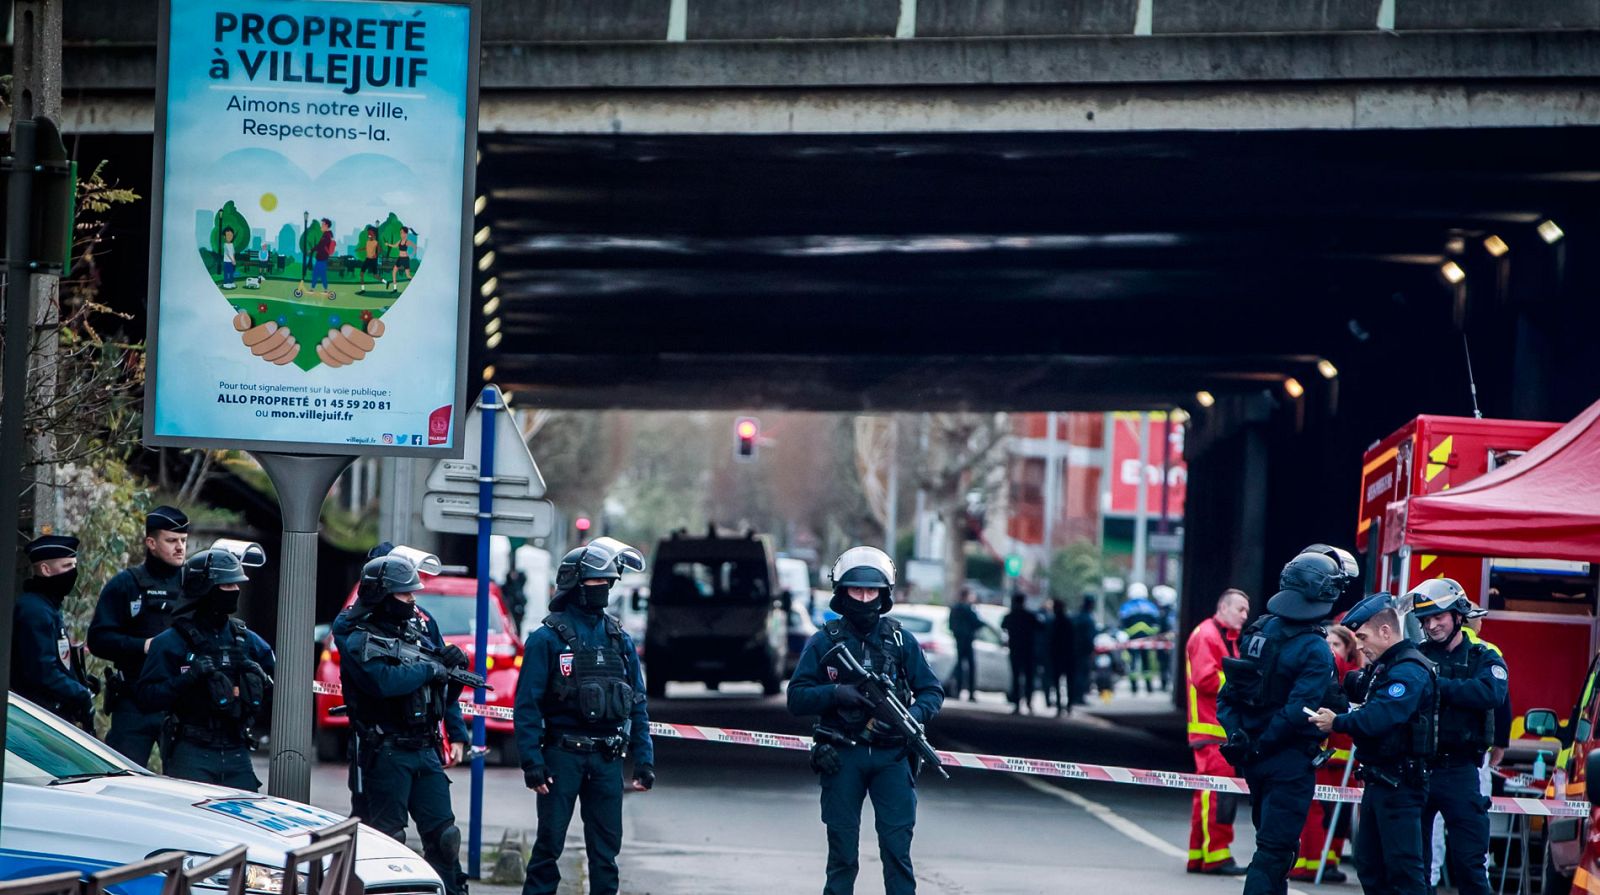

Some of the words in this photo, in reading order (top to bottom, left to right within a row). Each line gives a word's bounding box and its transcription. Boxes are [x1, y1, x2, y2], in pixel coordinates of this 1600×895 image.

[214, 10, 426, 51] PROPRETÉ
[208, 48, 230, 80] à
[237, 50, 428, 95] VILLEJUIF
[226, 95, 300, 114] Aimons
[306, 100, 360, 117] notre
[365, 102, 408, 121] ville,
[243, 119, 391, 141] Respectons-la.
[219, 381, 238, 390] Pour
[240, 383, 257, 391] tout
[259, 383, 308, 393] signalement
[324, 386, 330, 394] la
[333, 387, 350, 395] voie
[351, 387, 387, 397] publique
[217, 394, 247, 404] ALLO
[250, 395, 309, 407] PROPRETÉ
[314, 398, 327, 408] 01
[330, 399, 344, 408] 45
[346, 400, 360, 409] 59
[362, 400, 376, 410] 20
[378, 401, 391, 410] 81
[255, 409, 268, 418] ou
[271, 410, 353, 422] mon.villejuif.fr
[1249, 638, 1261, 656] A
